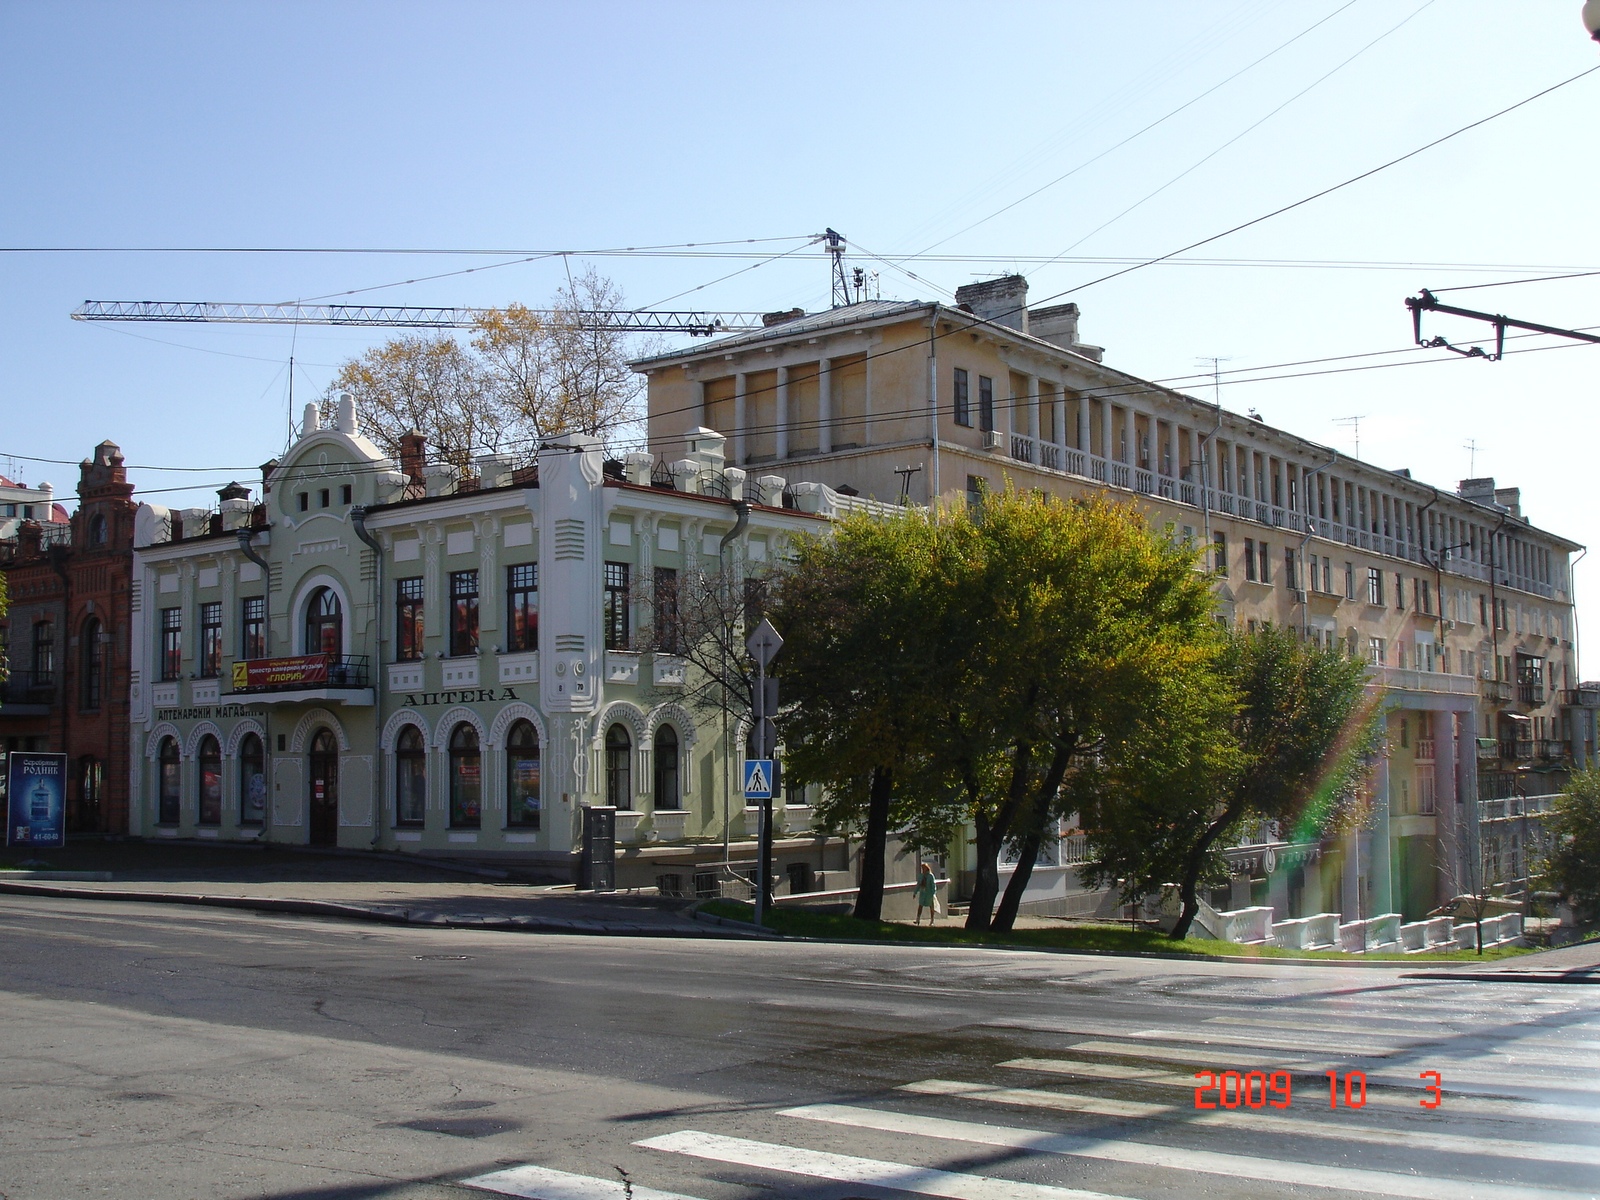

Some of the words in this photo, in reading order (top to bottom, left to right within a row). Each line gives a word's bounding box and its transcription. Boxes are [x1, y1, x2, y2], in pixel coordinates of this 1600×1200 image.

[235, 666, 245, 678] 7
[401, 687, 520, 707] АПТЕКА
[23, 766, 59, 775] РОДНИК
